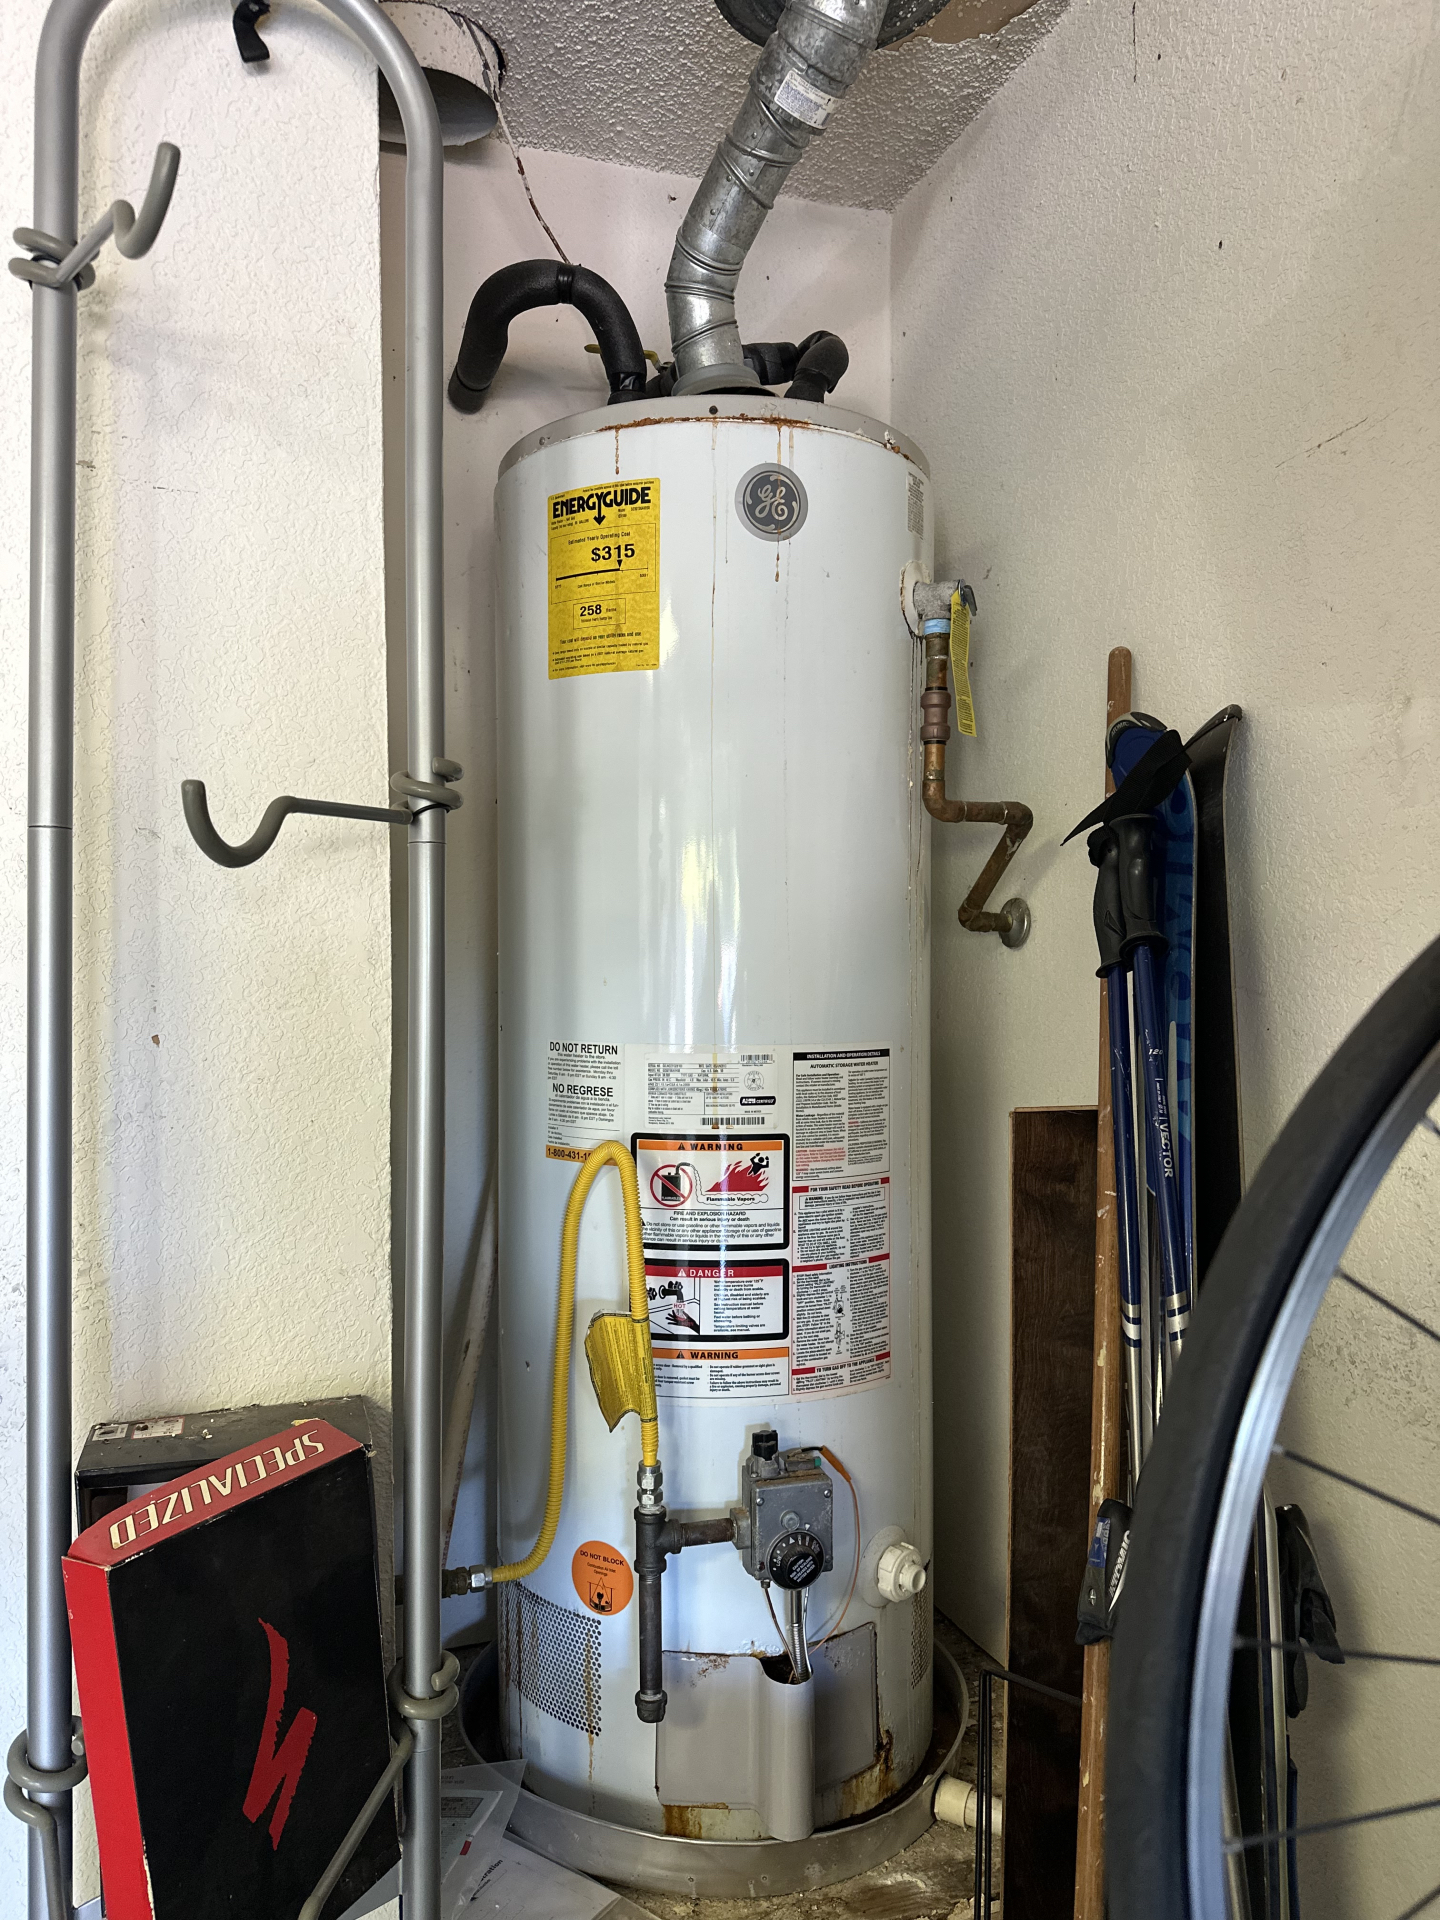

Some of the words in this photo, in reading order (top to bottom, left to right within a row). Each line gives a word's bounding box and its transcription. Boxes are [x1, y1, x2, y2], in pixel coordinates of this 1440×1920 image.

[553, 486, 651, 520] ENERGYGUIDE
[754, 484, 788, 521] GE
[600, 532, 620, 540] Operating
[591, 543, 635, 563] $315
[579, 604, 602, 617] 258
[550, 1041, 560, 1052] DO
[562, 1042, 579, 1053] NOT
[580, 1043, 618, 1055] RETURN
[552, 1082, 565, 1093] NO
[567, 1084, 613, 1097] REGRESE
[547, 1147, 592, 1161] 1-800-431-1
[690, 1143, 743, 1151] WARNING
[1158, 1122, 1174, 1178] VECTOR
[689, 1269, 734, 1277] DANGER
[690, 1351, 739, 1359] WARNING
[109, 1429, 325, 1550] SPECIALIZED
[580, 1549, 588, 1557] DO
[589, 1552, 601, 1561] NOT
[602, 1556, 624, 1566] BLOCK
